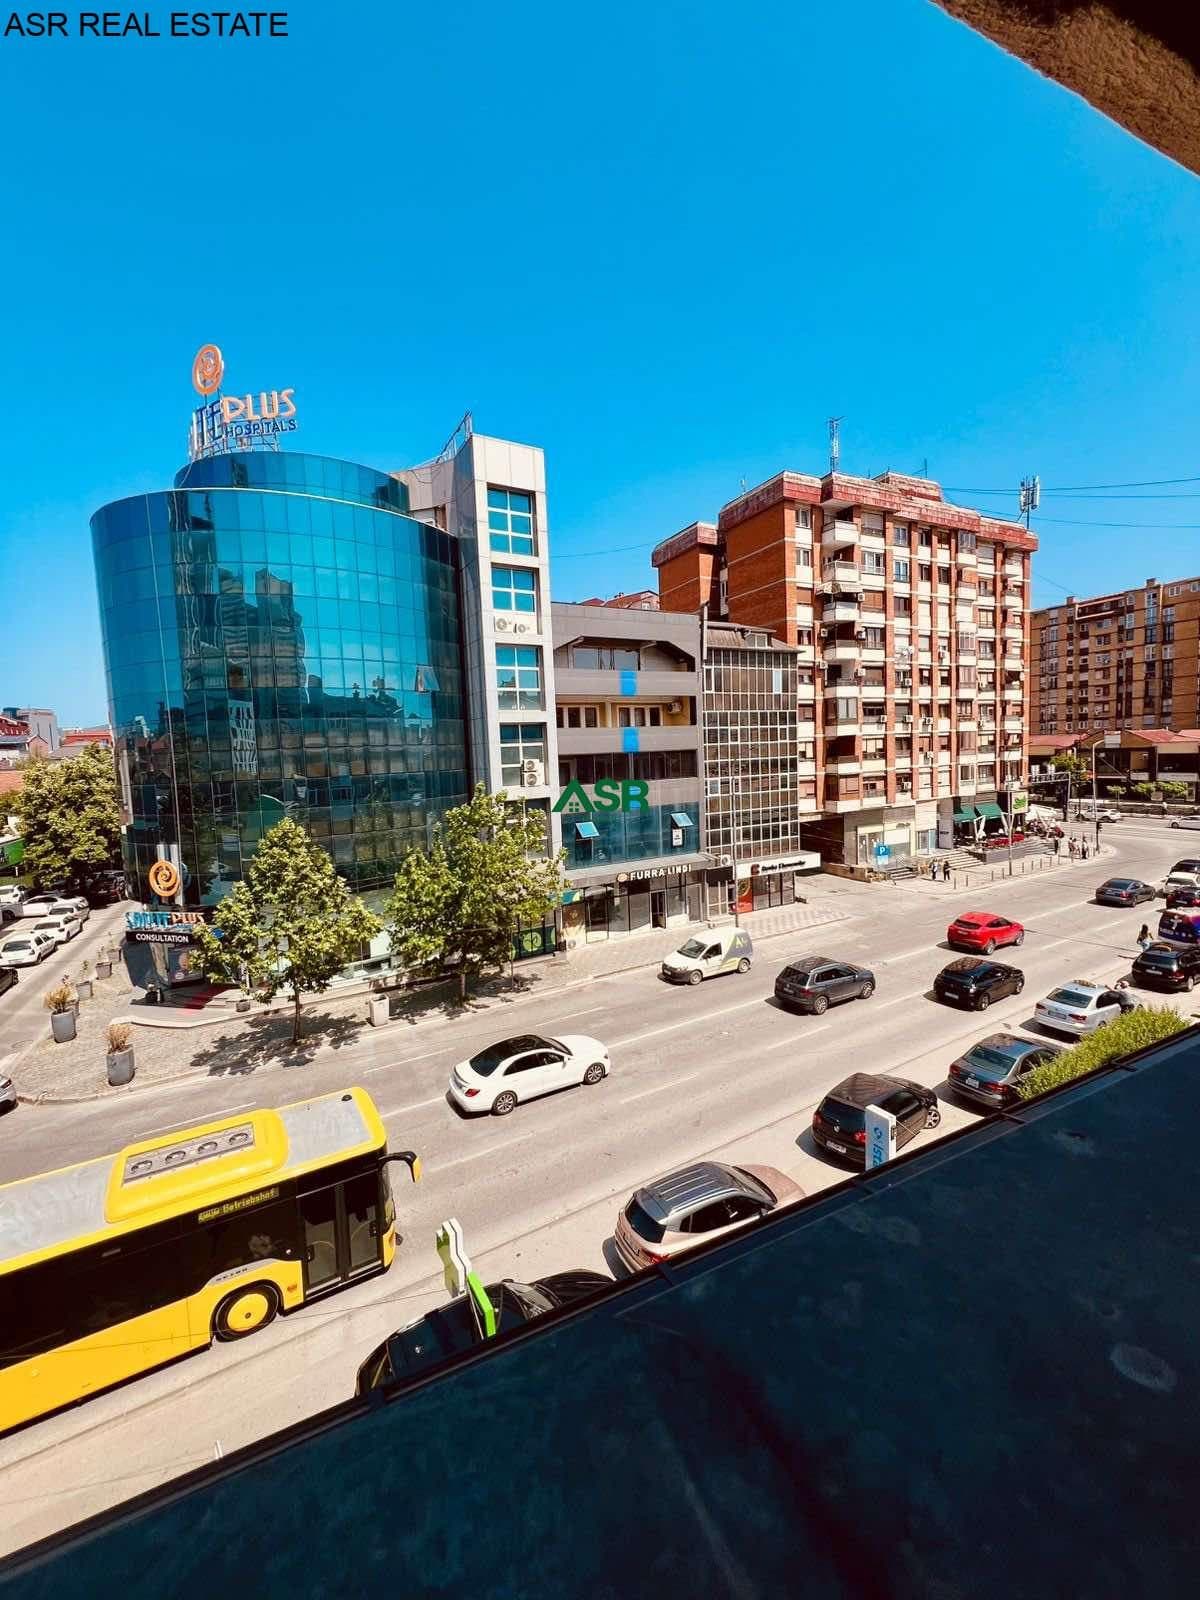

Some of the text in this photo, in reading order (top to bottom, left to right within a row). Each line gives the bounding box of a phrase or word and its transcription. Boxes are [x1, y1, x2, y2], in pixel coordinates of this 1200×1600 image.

[221, 388, 297, 423] PLUS
[225, 419, 298, 438] HOSPITALS
[630, 863, 692, 881] FURRA LINDI
[135, 932, 189, 943] CONSULTATION
